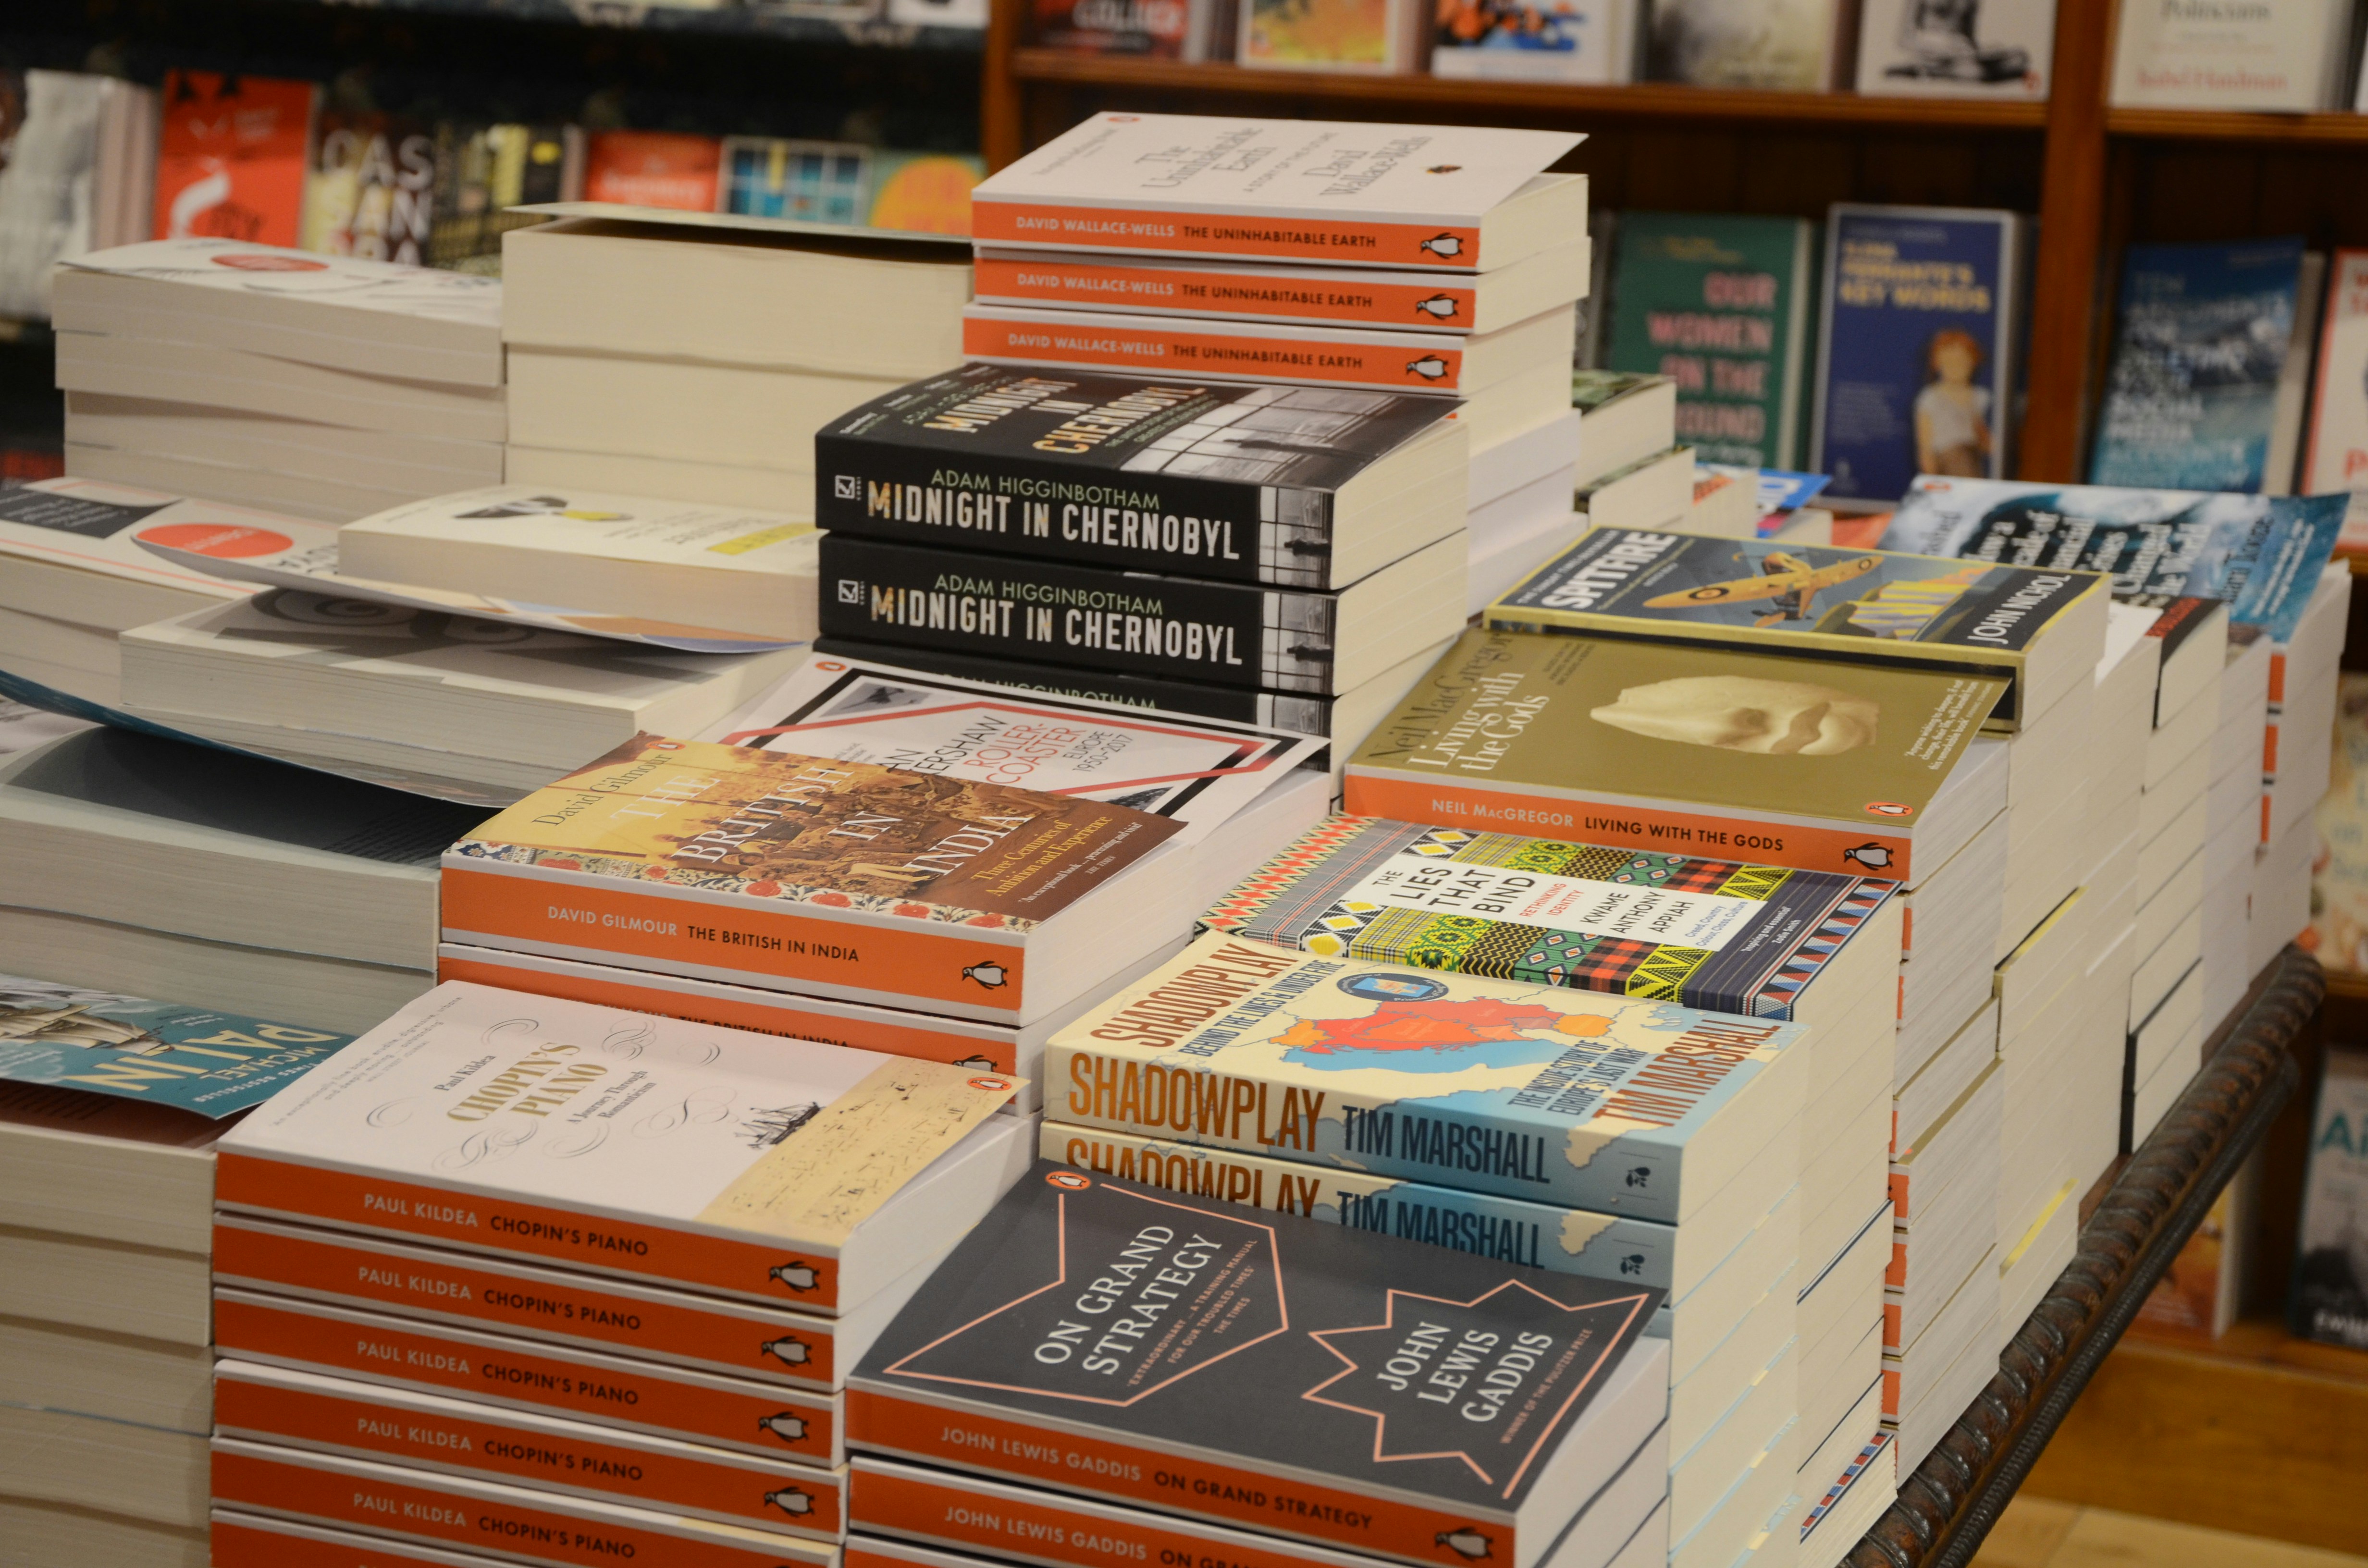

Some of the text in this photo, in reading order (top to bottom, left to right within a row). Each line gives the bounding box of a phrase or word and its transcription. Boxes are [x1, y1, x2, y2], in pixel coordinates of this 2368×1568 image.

[1134, 145, 1191, 164] The
[1141, 127, 1263, 188] Uninhabitable
[1211, 145, 1278, 172] Earth
[1302, 149, 1369, 178] David
[1319, 135, 1432, 196] Wallace-Wells
[1016, 217, 1377, 247] DAVID WALLACE-WELLS THE UNINHABITABLE EARTH
[1703, 271, 1778, 309] OUR
[1893, 285, 1991, 314] WORDS
[1009, 333, 1363, 368] DAVID WALLACE-WELLS THE UNINHABITABLE EARTH
[1647, 312, 1774, 352] WOMEN
[923, 377, 1078, 433] MIDNIGHT
[1713, 360, 1770, 398] THE
[1028, 399, 1094, 415] IN
[1031, 387, 1207, 454] CHERNOBYL
[931, 468, 1160, 510] ADAM HIGGINBOTHAM
[867, 480, 1011, 533] MIDNIGHT
[1023, 501, 1050, 539] IN
[1062, 503, 1241, 561] CHERNOBYL
[934, 574, 1164, 616] ADAM HIGGINBOTHAM
[1541, 531, 1679, 610] SPITFIRE
[870, 584, 1015, 638] MIDNIGHT
[1025, 606, 1053, 643] IN
[1065, 607, 1244, 666] CHERNOBYL
[1967, 575, 2072, 645] JOHN NICHOL
[1368, 632, 1514, 760] Neil MacGregor
[1406, 673, 1526, 769] Living with
[913, 716, 1009, 774] ERSHAW
[962, 723, 1048, 769] ROLLER-
[986, 727, 1087, 784] COASTER
[1062, 731, 1114, 760] EUROPE
[1455, 695, 1550, 771] the Gods
[531, 753, 672, 827] David Gilmour
[610, 775, 722, 821] THE
[671, 765, 855, 864] BRITISH
[827, 810, 903, 841] IN
[901, 816, 1042, 876] INDIA
[970, 820, 1073, 881] Three Centuries of
[1431, 798, 1468, 817] NEIL
[1585, 816, 1643, 836] LIVING
[1648, 824, 1694, 842] WITH
[1698, 829, 1729, 845] THE
[1733, 833, 1785, 852] GODS
[985, 816, 1113, 897] Ambition and Experience
[1371, 870, 1404, 886] THE
[1390, 867, 1453, 900] LIES
[1429, 869, 1497, 908] THAT
[1471, 875, 1537, 914] BIND
[1519, 882, 1568, 918] RETHINKING
[1549, 890, 1585, 917] IDENTITY
[1579, 892, 1629, 925] KWAME
[1612, 891, 1667, 935] ANTHONY
[547, 906, 861, 962] DAVID GILMOUR THE BRITISH IN INDIA
[1648, 900, 1695, 934] APPIAH
[1685, 905, 1727, 938] Creed, Country
[1695, 901, 1749, 947] Colour, Class, Culture
[1762, 924, 1775, 934] and
[1771, 919, 1802, 944] Zadie Smith
[1089, 942, 1299, 1048] SHADOWPLAY
[1260, 992, 1297, 1000] &
[1268, 972, 1316, 993] UNDER
[1298, 959, 1347, 983] FIRE
[1213, 1014, 1261, 1030] THE
[1233, 996, 1287, 1018] LINES
[61, 1023, 342, 1092] PALIN
[198, 1045, 331, 1080] MICHAEL
[1178, 1028, 1242, 1057] BEHIND
[433, 1054, 496, 1091] Paul Kildea
[446, 1041, 580, 1122] CHOPIN'S
[508, 1063, 610, 1118] PIANO
[567, 1069, 649, 1125] A Journey Through
[1507, 1040, 1611, 1109] THE INSIDE STORY OF
[1546, 1047, 1649, 1116] EUROPE'S LAST WAR
[1591, 1019, 1782, 1127] TIM MARSHALL
[597, 1081, 657, 1119] Romanticism
[1068, 1052, 1552, 1185] SHADOWPLAY TIM MARSHALL
[364, 1194, 649, 1257] PAUL KILDEA CHOPIN'S PIANO
[358, 1267, 641, 1331] PAUL KILDEA CHOPIN'S PIANO
[1034, 1225, 1175, 1364] ON GRAND
[1195, 1266, 1232, 1306] TRAINING
[1225, 1239, 1259, 1270] MANUAL
[1082, 1234, 1222, 1376] STRATEGY
[1166, 1351, 1187, 1365] FOR
[1181, 1327, 1202, 1348] OUR
[1198, 1288, 1237, 1330] TROUBLED
[1212, 1296, 1252, 1335] THE TIMES
[357, 1341, 640, 1406] PAUL KILDEA CHOPIN'S PIANO
[1376, 1321, 1452, 1391] JOHN
[1417, 1329, 1501, 1405] LEWIS
[1461, 1331, 1554, 1422] GADDIS
[940, 1427, 1374, 1531] JOHN LEWIS GADDIS ON GRAND STRATEGY
